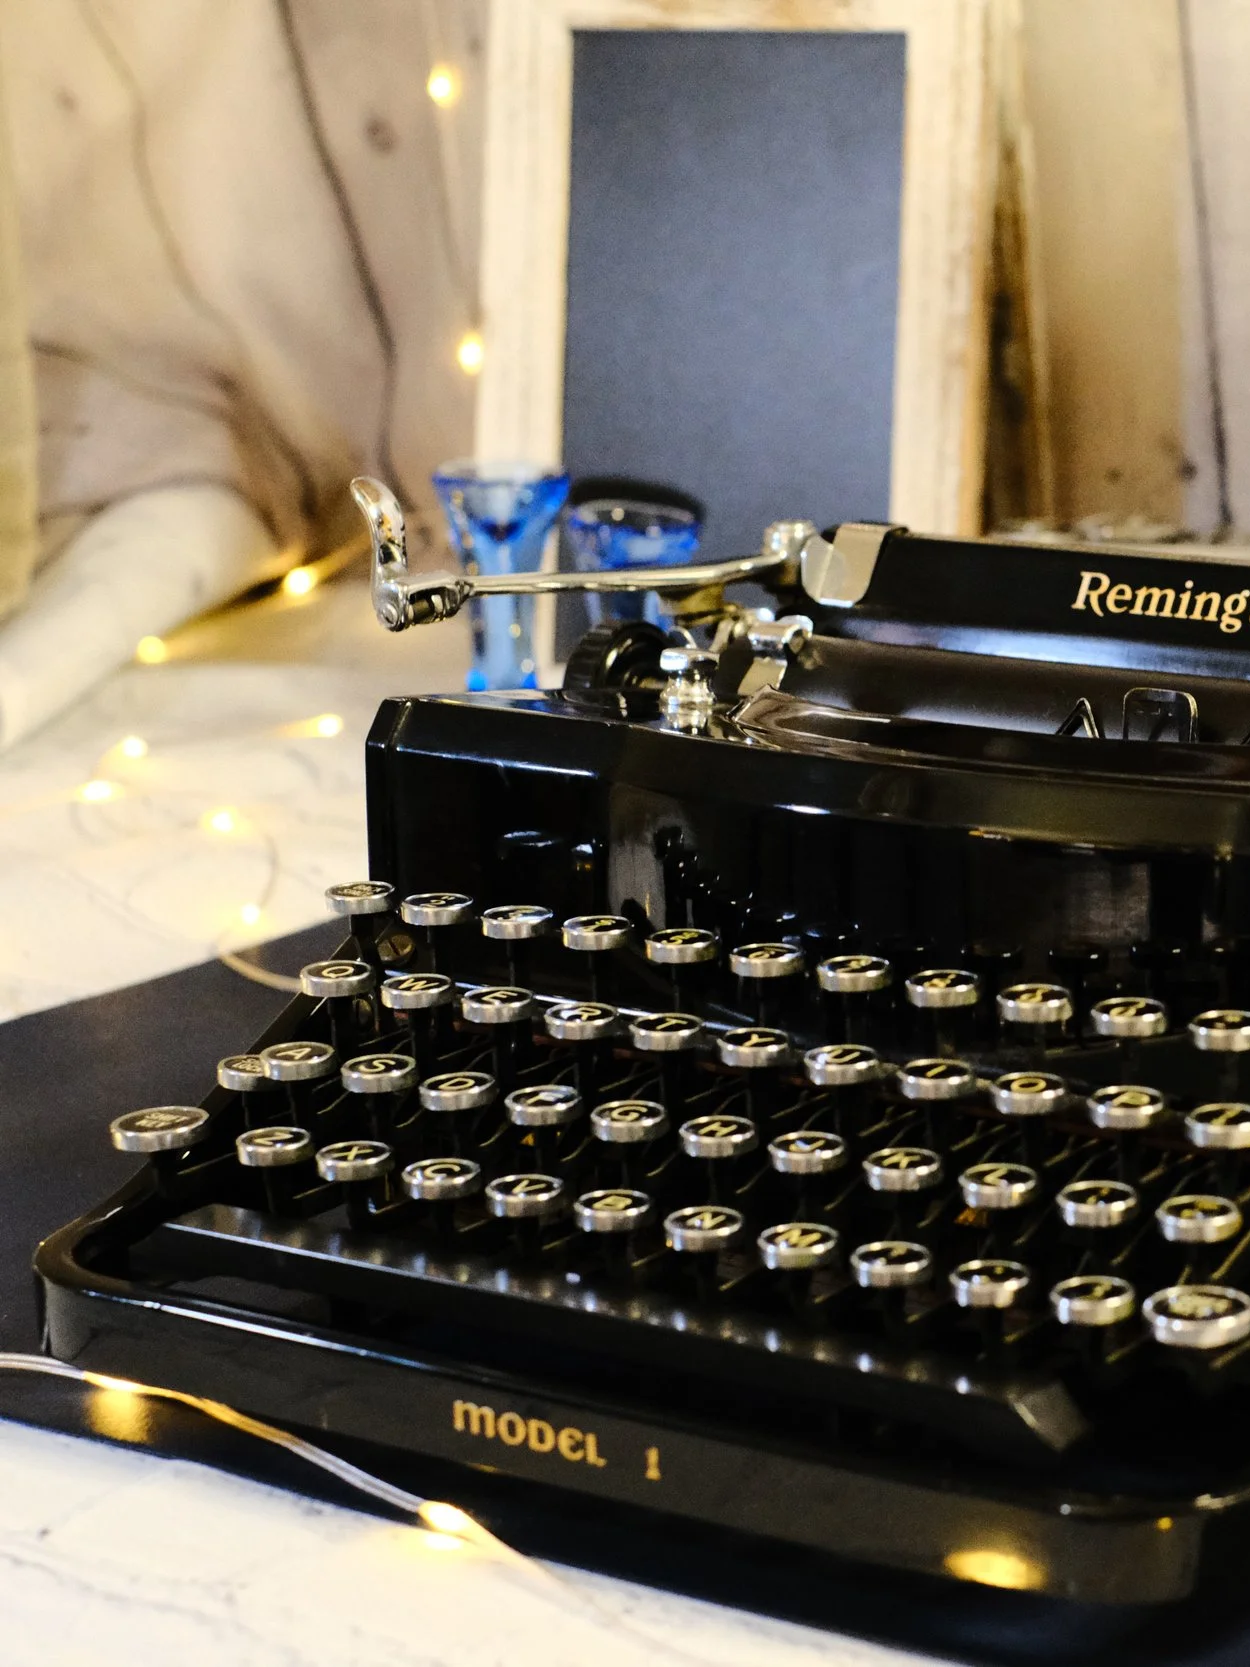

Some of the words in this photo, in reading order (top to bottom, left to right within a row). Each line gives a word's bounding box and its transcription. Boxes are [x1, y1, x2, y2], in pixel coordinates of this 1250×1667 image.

[321, 965, 355, 979] Q
[397, 977, 440, 991] W
[482, 990, 519, 1004] E
[564, 1006, 602, 1022] R
[656, 1017, 688, 1030] T
[742, 1033, 776, 1047] Y
[276, 1046, 312, 1060] A
[826, 1048, 861, 1064] U
[358, 1058, 397, 1073] S
[438, 1076, 476, 1090] D
[1010, 1076, 1048, 1093] O
[611, 1105, 649, 1122] G
[698, 1121, 739, 1138] H
[253, 1132, 294, 1146] Z
[330, 1145, 374, 1161] X
[423, 1163, 462, 1181] C
[511, 1179, 548, 1194] V
[685, 1210, 727, 1230] N
[452, 1399, 608, 1468] MODEL
[644, 1446, 662, 1481] 1
